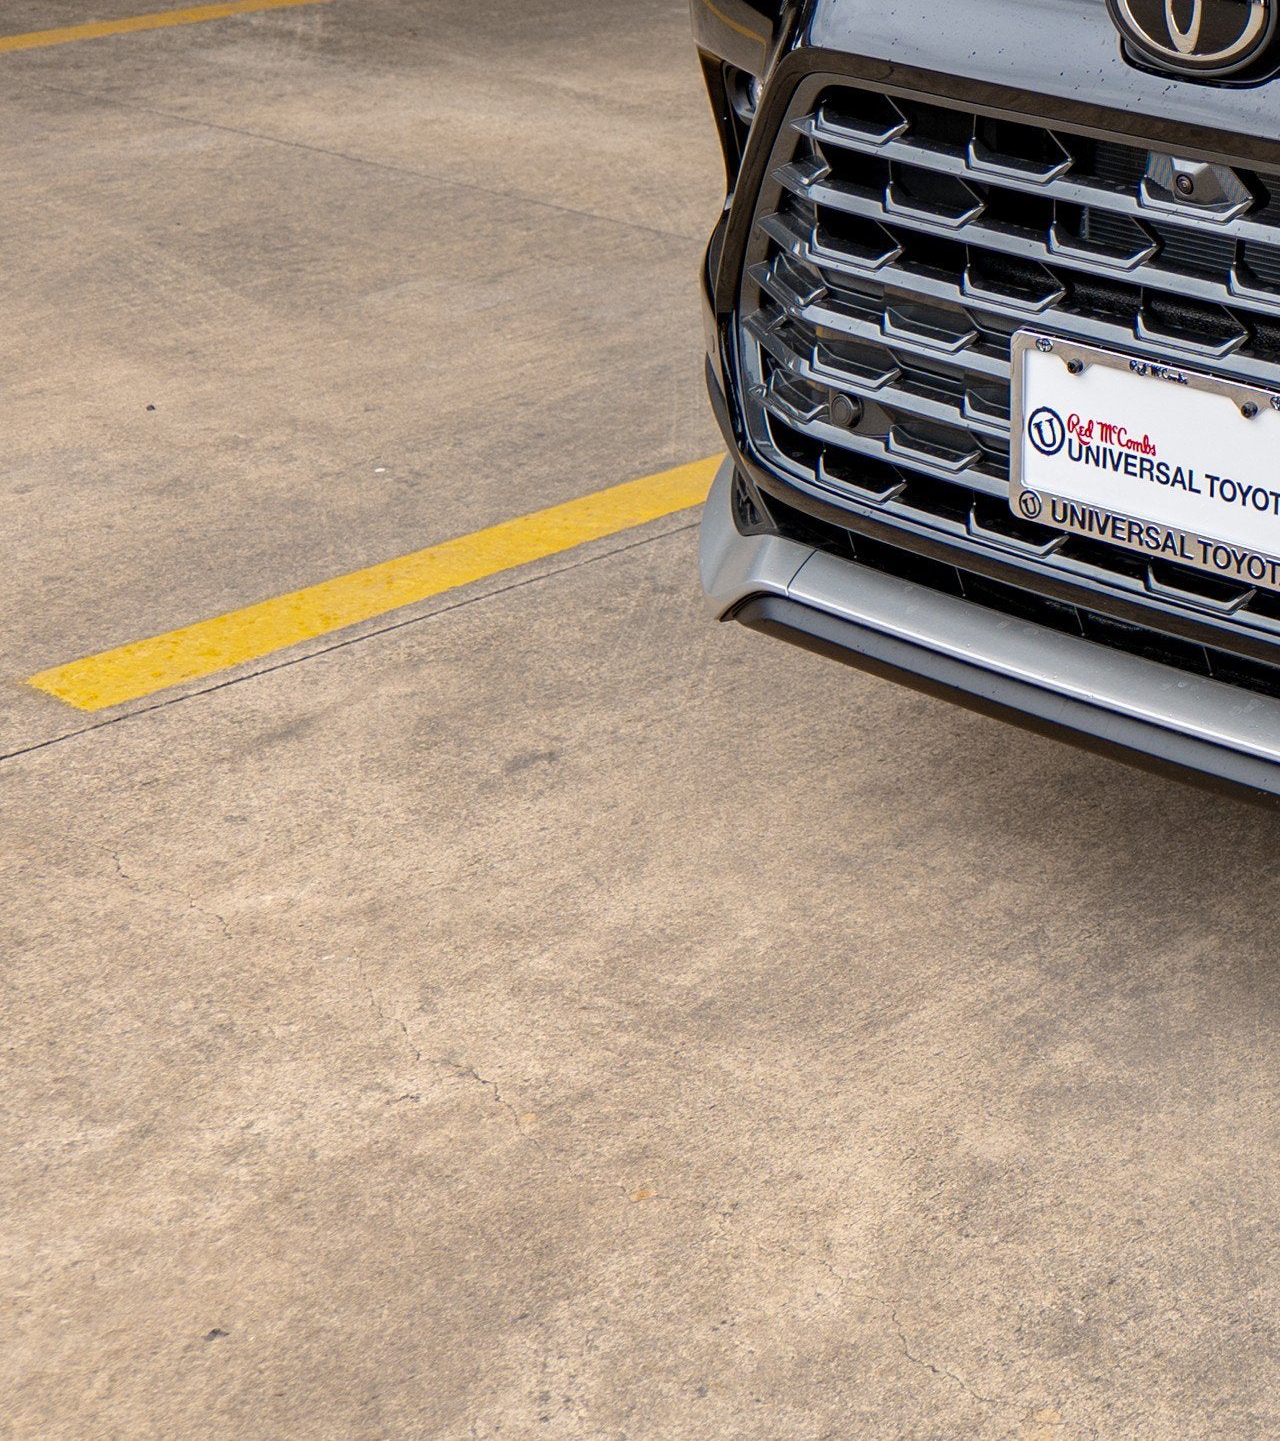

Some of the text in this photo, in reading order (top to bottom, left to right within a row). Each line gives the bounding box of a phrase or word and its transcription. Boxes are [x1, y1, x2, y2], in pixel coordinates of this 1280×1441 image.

[1066, 412, 1157, 457] Red McCombs
[1067, 437, 1202, 495] UNIVERSAL
[1051, 498, 1195, 561] UNIVERSAL
